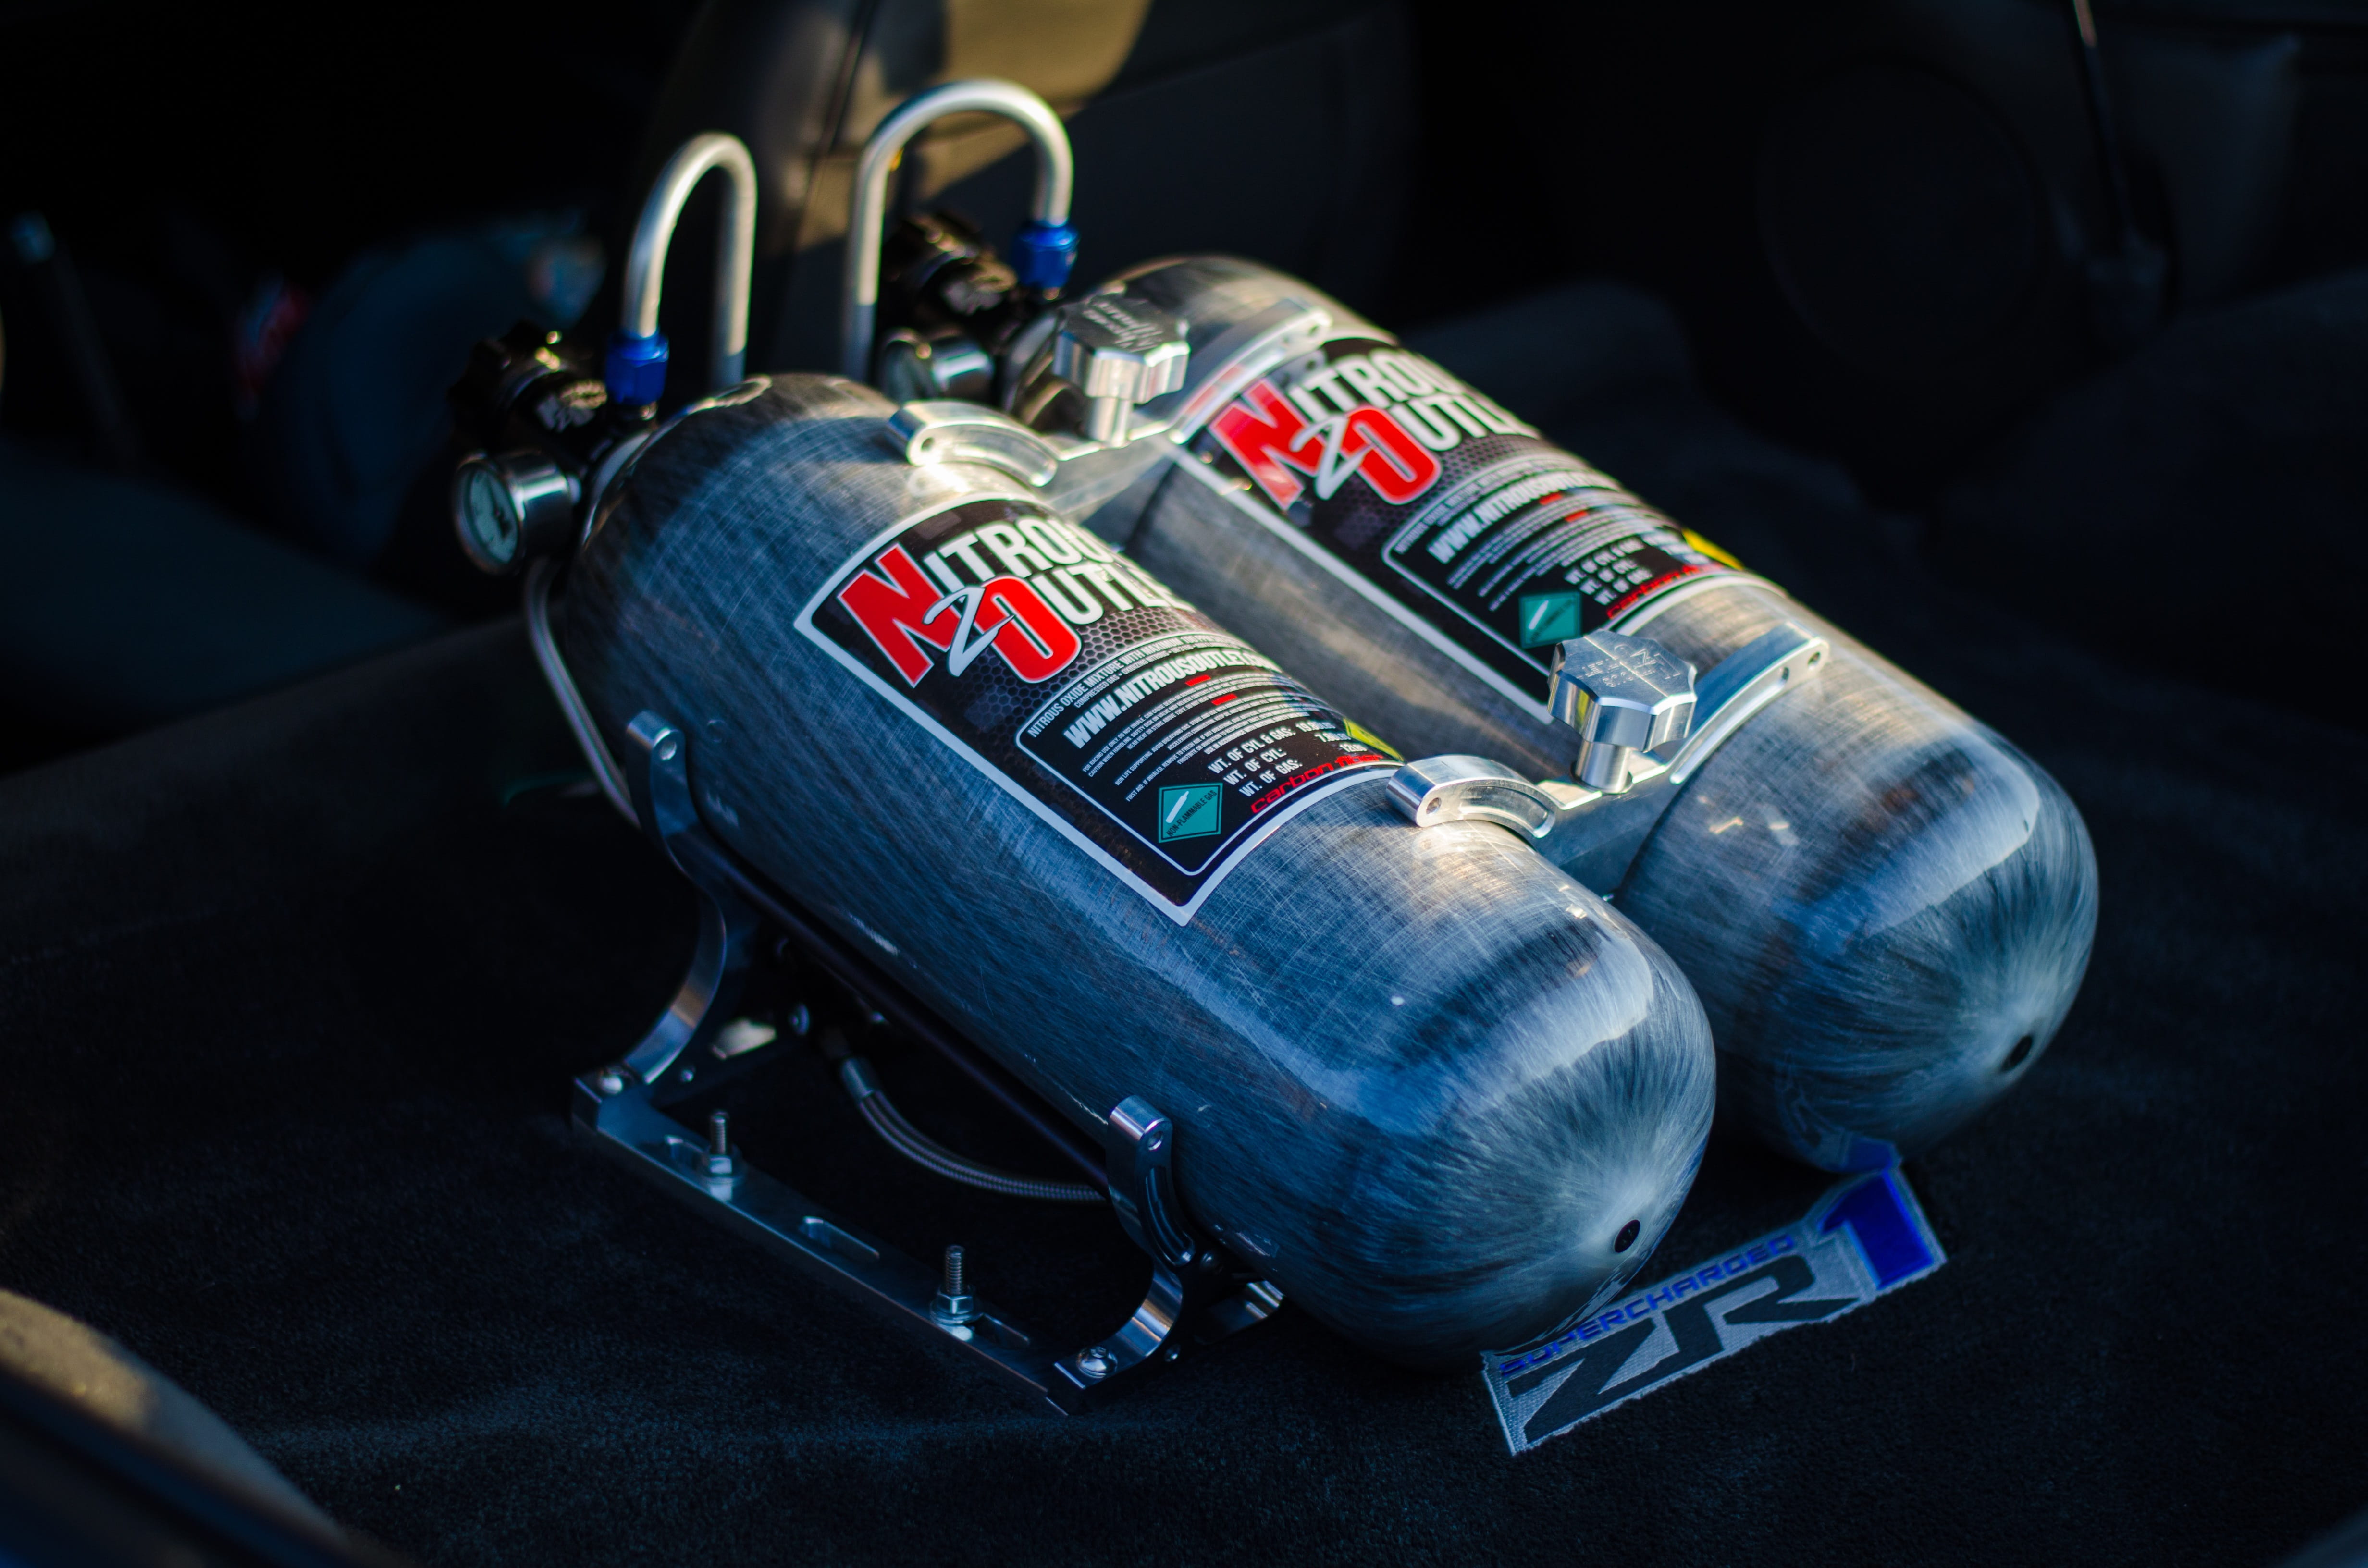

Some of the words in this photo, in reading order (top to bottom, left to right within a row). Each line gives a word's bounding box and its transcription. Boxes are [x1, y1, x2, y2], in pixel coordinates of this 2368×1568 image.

[1208, 348, 1471, 510] NITROU
[838, 516, 1149, 688] NITROU
[975, 560, 1196, 683] OUTLE
[1027, 701, 1065, 738] NITROUS
[1059, 683, 1089, 706] OXIDE
[1083, 660, 1125, 687] MIXTURE
[1118, 649, 1146, 665] WITH
[1139, 637, 1184, 655] MAXIMUM
[1063, 649, 1282, 749] WWW.NITROUSOUTLET.C
[1073, 680, 1110, 708] COMPRESSED
[1106, 674, 1121, 684] GAS
[1120, 658, 1149, 675] OXIDIZING
[1145, 650, 1170, 662] NITROUS
[1082, 763, 1092, 773] FOR
[1089, 751, 1104, 766] RACING
[1101, 745, 1110, 753] USE
[1108, 736, 1120, 747] ONLY.
[1130, 716, 1146, 729] INHALE.
[1150, 704, 1165, 713] CAUSE
[1162, 697, 1177, 706] DEATH
[1088, 760, 1105, 777] CAUTION
[1102, 751, 1115, 763] WHEN
[1112, 735, 1133, 753] HANDLING.
[1130, 725, 1146, 738] SAFETY
[1143, 719, 1155, 728] DISK
[1157, 708, 1171, 718] VALVE
[1114, 776, 1124, 786] NON
[1122, 769, 1132, 778] LIFE
[1129, 750, 1153, 772] SUPPORTING.
[1150, 742, 1164, 752] AVOID
[1161, 728, 1184, 744] BREATHING
[1188, 716, 1203, 726] STORE
[1126, 739, 1139, 750] NEAR
[1136, 732, 1148, 742] HEAT
[1150, 720, 1165, 731] STORE
[1162, 712, 1177, 723] ABOVE
[1167, 731, 1193, 750] ACCELERATES
[1176, 748, 1198, 765] FROSTBITE
[1200, 733, 1222, 747] IRRITATION
[1203, 746, 1216, 755] USE
[1217, 729, 1246, 746] ACCORDANCE
[1207, 756, 1233, 775] WT.
[1225, 747, 1246, 762] OF
[1239, 737, 1266, 754] CYL
[1258, 733, 1275, 744] &
[1267, 726, 1297, 740] GAS:
[1125, 790, 1138, 802] FIRST
[1161, 754, 1179, 768] REMOVE
[1181, 742, 1196, 752] FRESH
[1222, 767, 1248, 786] WT.
[1243, 758, 1264, 772] OF
[1258, 746, 1288, 763] CYL:
[1238, 779, 1264, 797] WT.
[1258, 770, 1280, 784] OF
[1273, 757, 1304, 775] GAS:
[1251, 763, 1334, 814] carbon
[1166, 798, 1207, 837] NON-FLAMMABLE
[1204, 790, 1217, 801] GAS
[1499, 1234, 1796, 1377] SUPERCHARGED
[1505, 1169, 1936, 1445] ZR1
